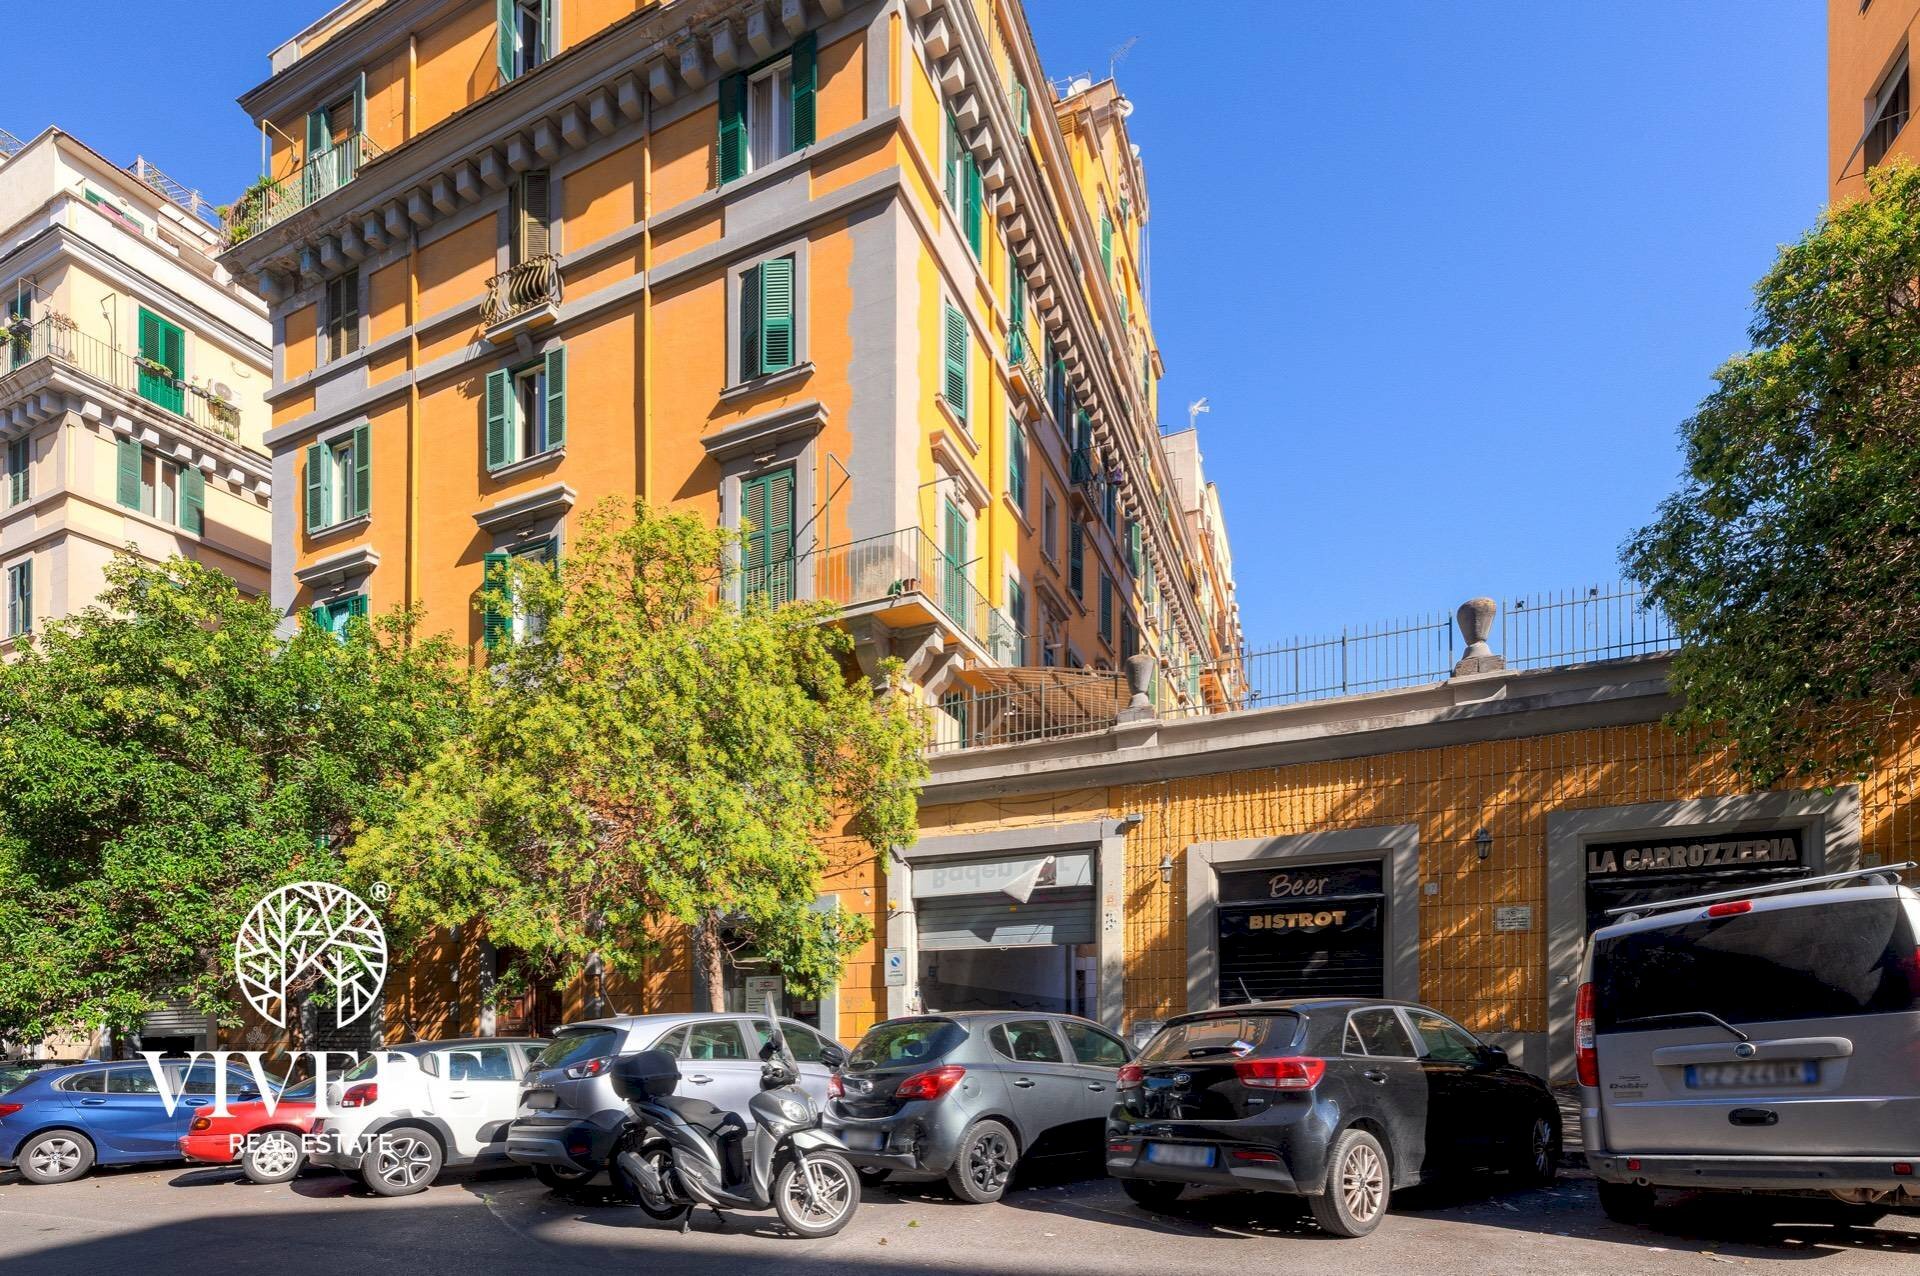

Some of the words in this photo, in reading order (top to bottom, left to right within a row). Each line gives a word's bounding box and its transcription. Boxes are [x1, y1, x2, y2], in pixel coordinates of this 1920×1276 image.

[1588, 850, 1617, 873] LA
[1623, 838, 1797, 870] CARROZZERIA
[1269, 874, 1329, 898] Beer
[1249, 910, 1346, 930] BISTROT
